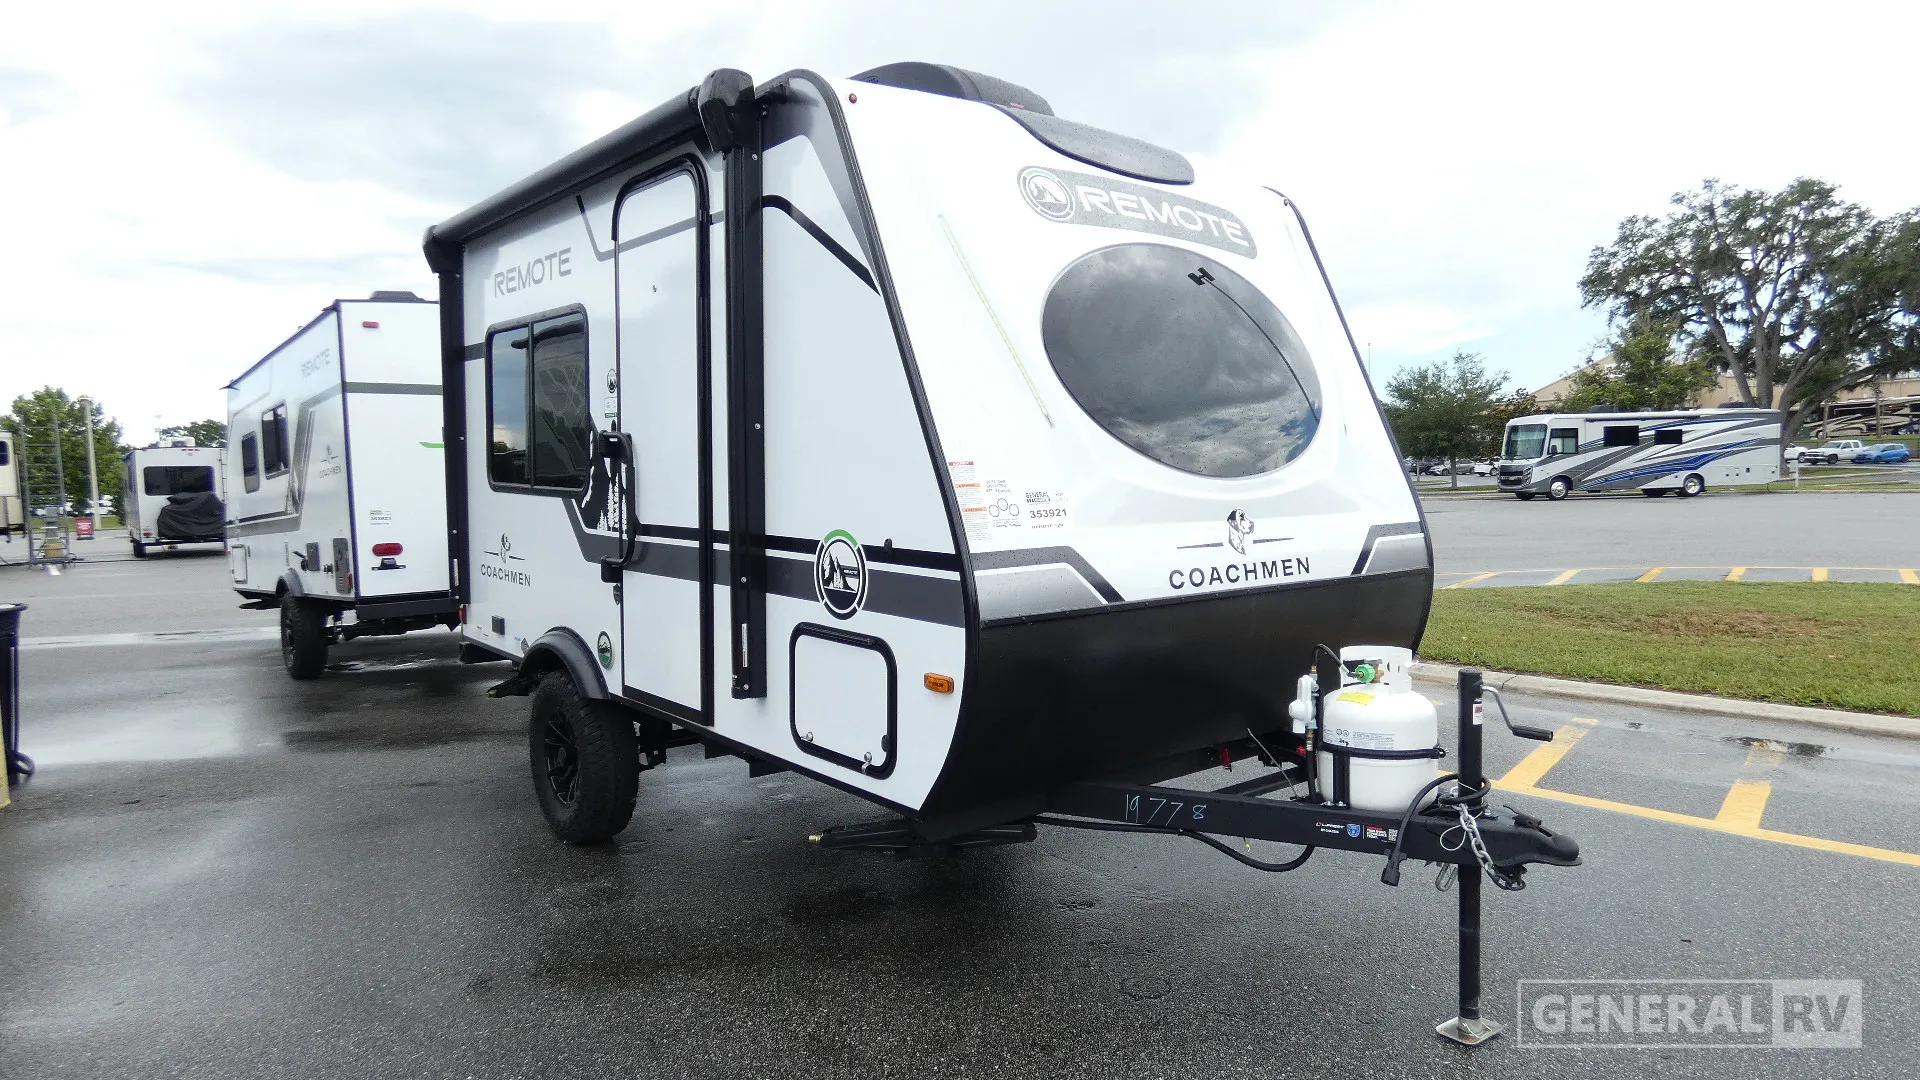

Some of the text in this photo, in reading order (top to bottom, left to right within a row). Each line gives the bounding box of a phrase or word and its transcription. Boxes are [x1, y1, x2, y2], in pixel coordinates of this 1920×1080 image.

[1075, 184, 1250, 247] REMOTE
[494, 247, 572, 298] REMOTE
[1030, 508, 1067, 518] 353921
[480, 563, 531, 587] COACHMEN
[1169, 556, 1311, 590] COACHMEN
